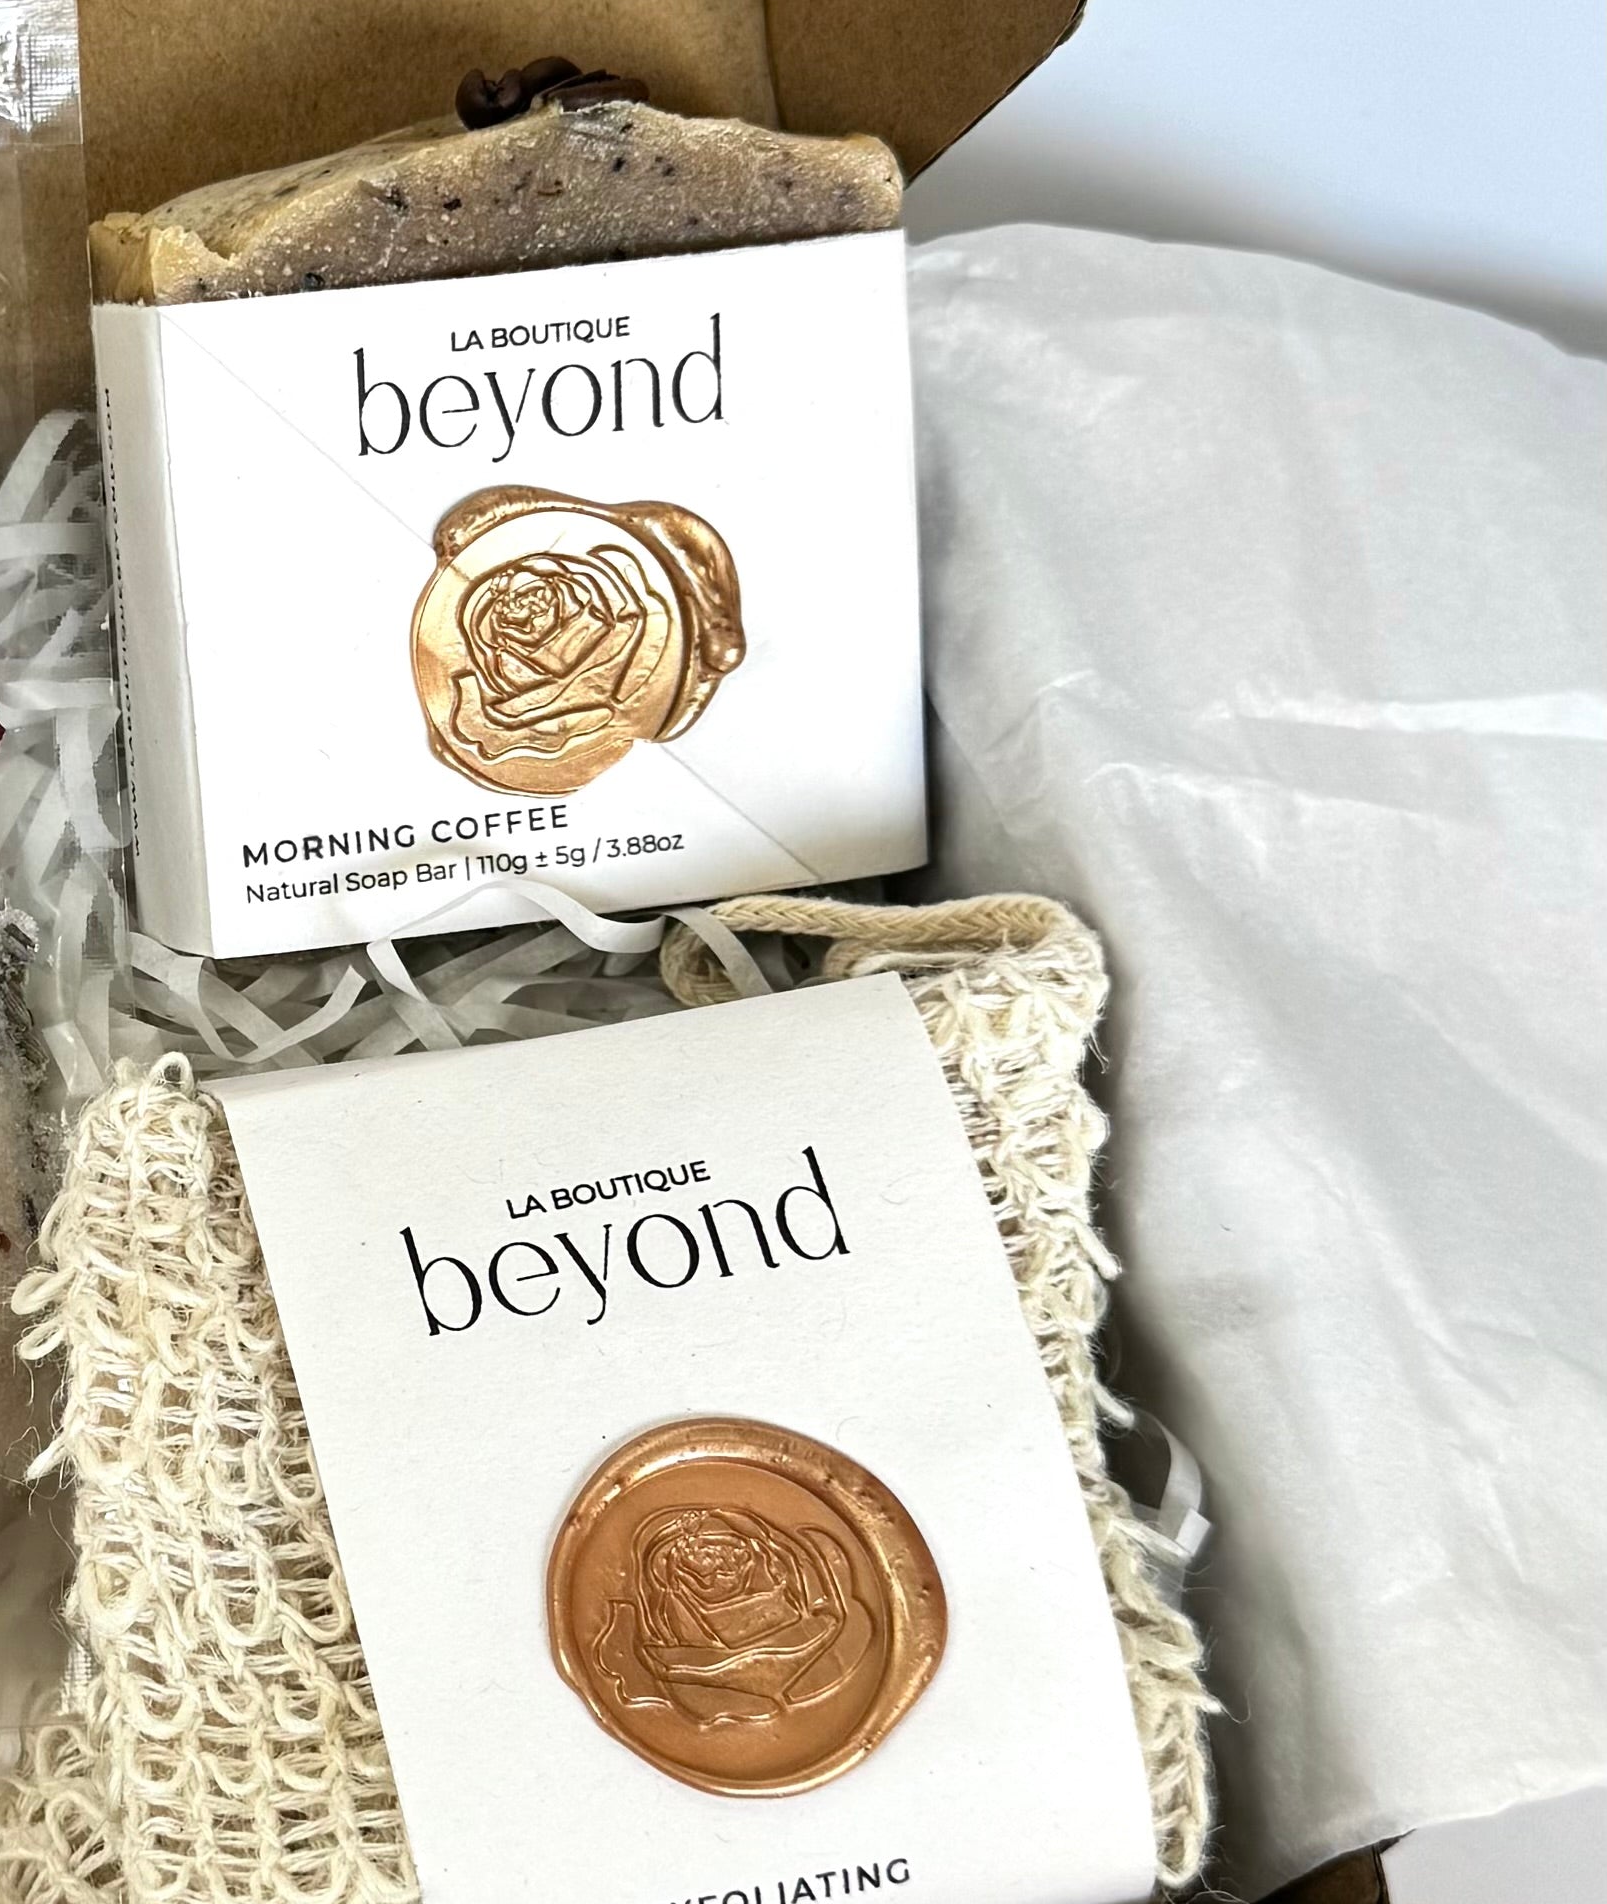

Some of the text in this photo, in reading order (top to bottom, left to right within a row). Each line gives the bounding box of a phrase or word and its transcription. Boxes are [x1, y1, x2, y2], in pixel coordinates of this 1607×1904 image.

[449, 314, 632, 354] LA BOUTIQUE
[351, 310, 726, 465] beyond
[241, 803, 570, 870] MORNING COFFEE
[245, 832, 686, 905] Natural Soap Bar | 110g ± 5g / 3.88oz
[504, 1158, 713, 1221] LA BOUTIQUE
[397, 1144, 853, 1338] beyond
